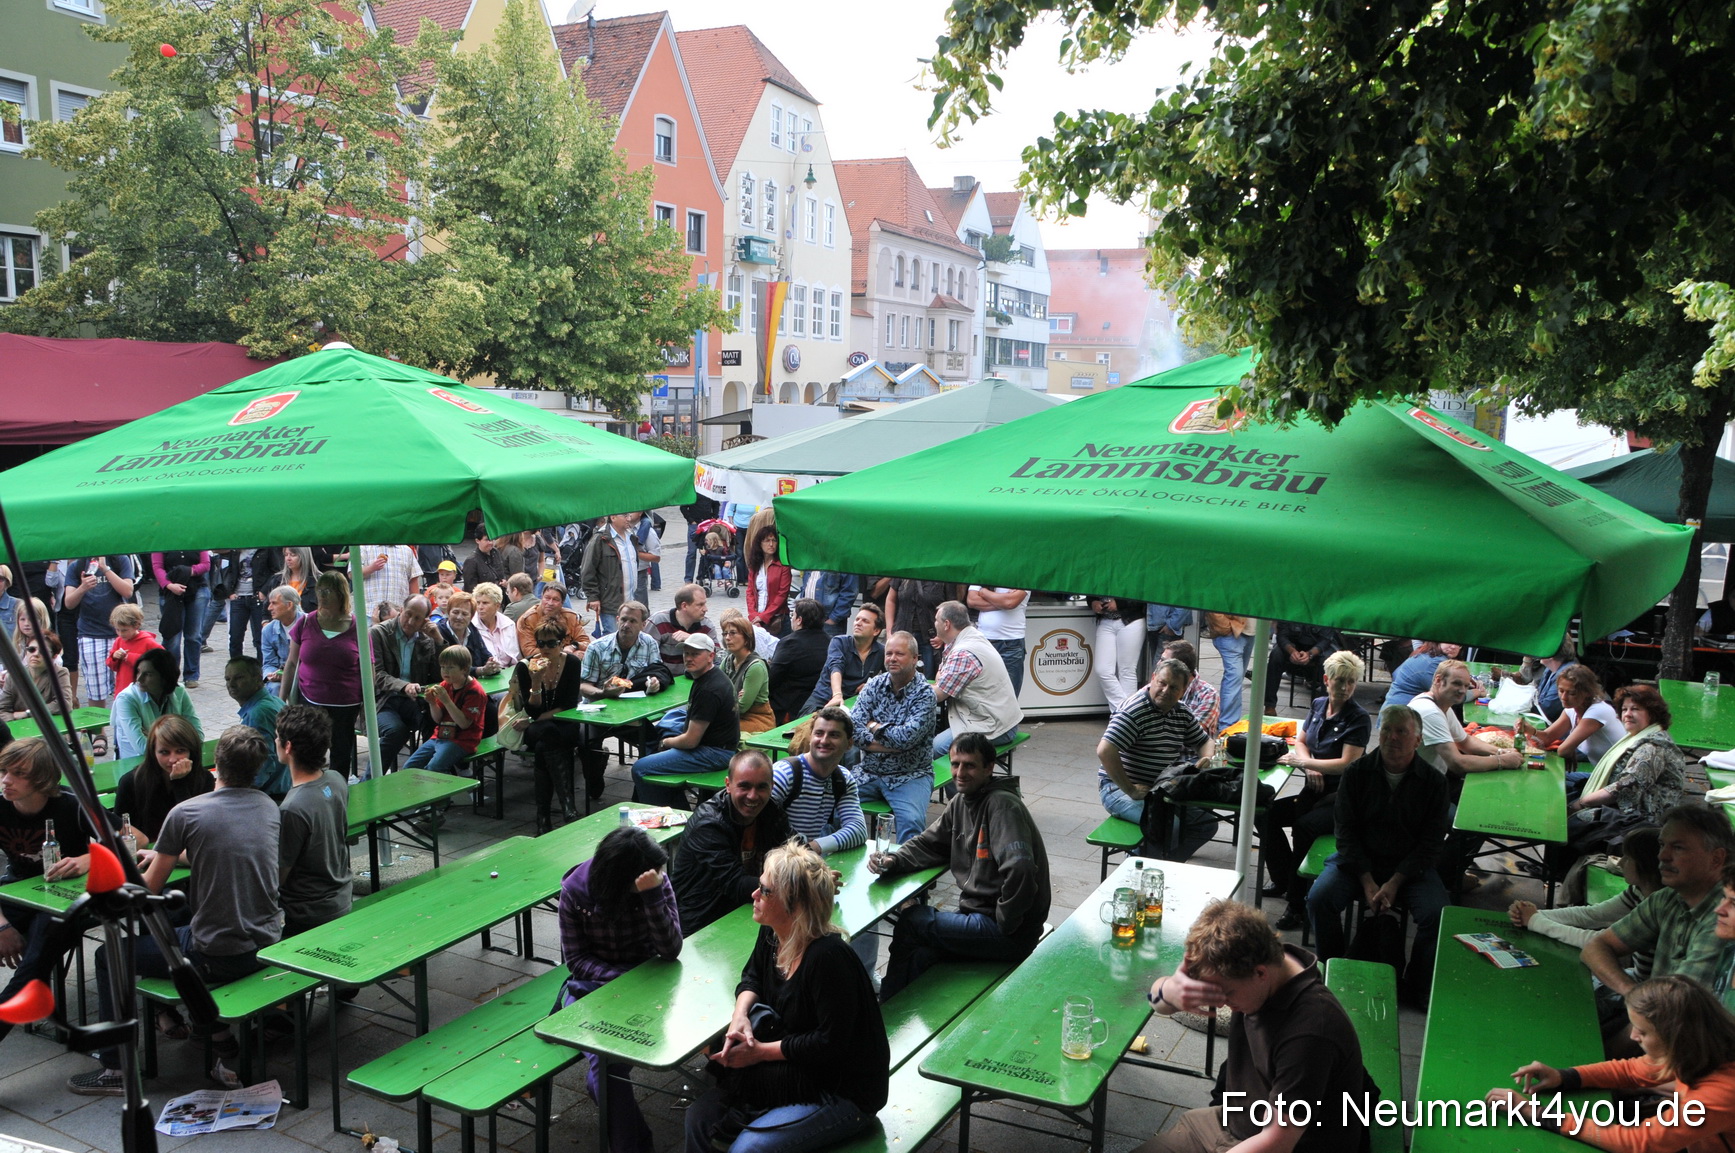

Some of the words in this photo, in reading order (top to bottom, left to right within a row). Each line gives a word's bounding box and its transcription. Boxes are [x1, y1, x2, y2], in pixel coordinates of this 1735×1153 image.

[722, 351, 739, 359] MATT
[150, 425, 315, 452] Neumarkter
[96, 438, 329, 473] Lammsbräu
[1073, 442, 1300, 467] Neumarkter
[76, 480, 107, 488] DAS
[111, 475, 152, 486] FEINE
[155, 465, 266, 480] ÖKOLOGISCHE
[271, 462, 306, 472] BIER
[1009, 456, 1329, 495] Lammsbräu
[988, 486, 1028, 494] DAS
[1032, 487, 1088, 496] FEINE
[1092, 487, 1249, 508] ÖKOLOGISCHE
[1257, 501, 1307, 513] BIER
[1038, 657, 1085, 666] Lammsbräu
[578, 1021, 657, 1048] Lammsbräu
[598, 1020, 653, 1039] Neumarkter
[964, 1059, 1056, 1086] Lammsbräu
